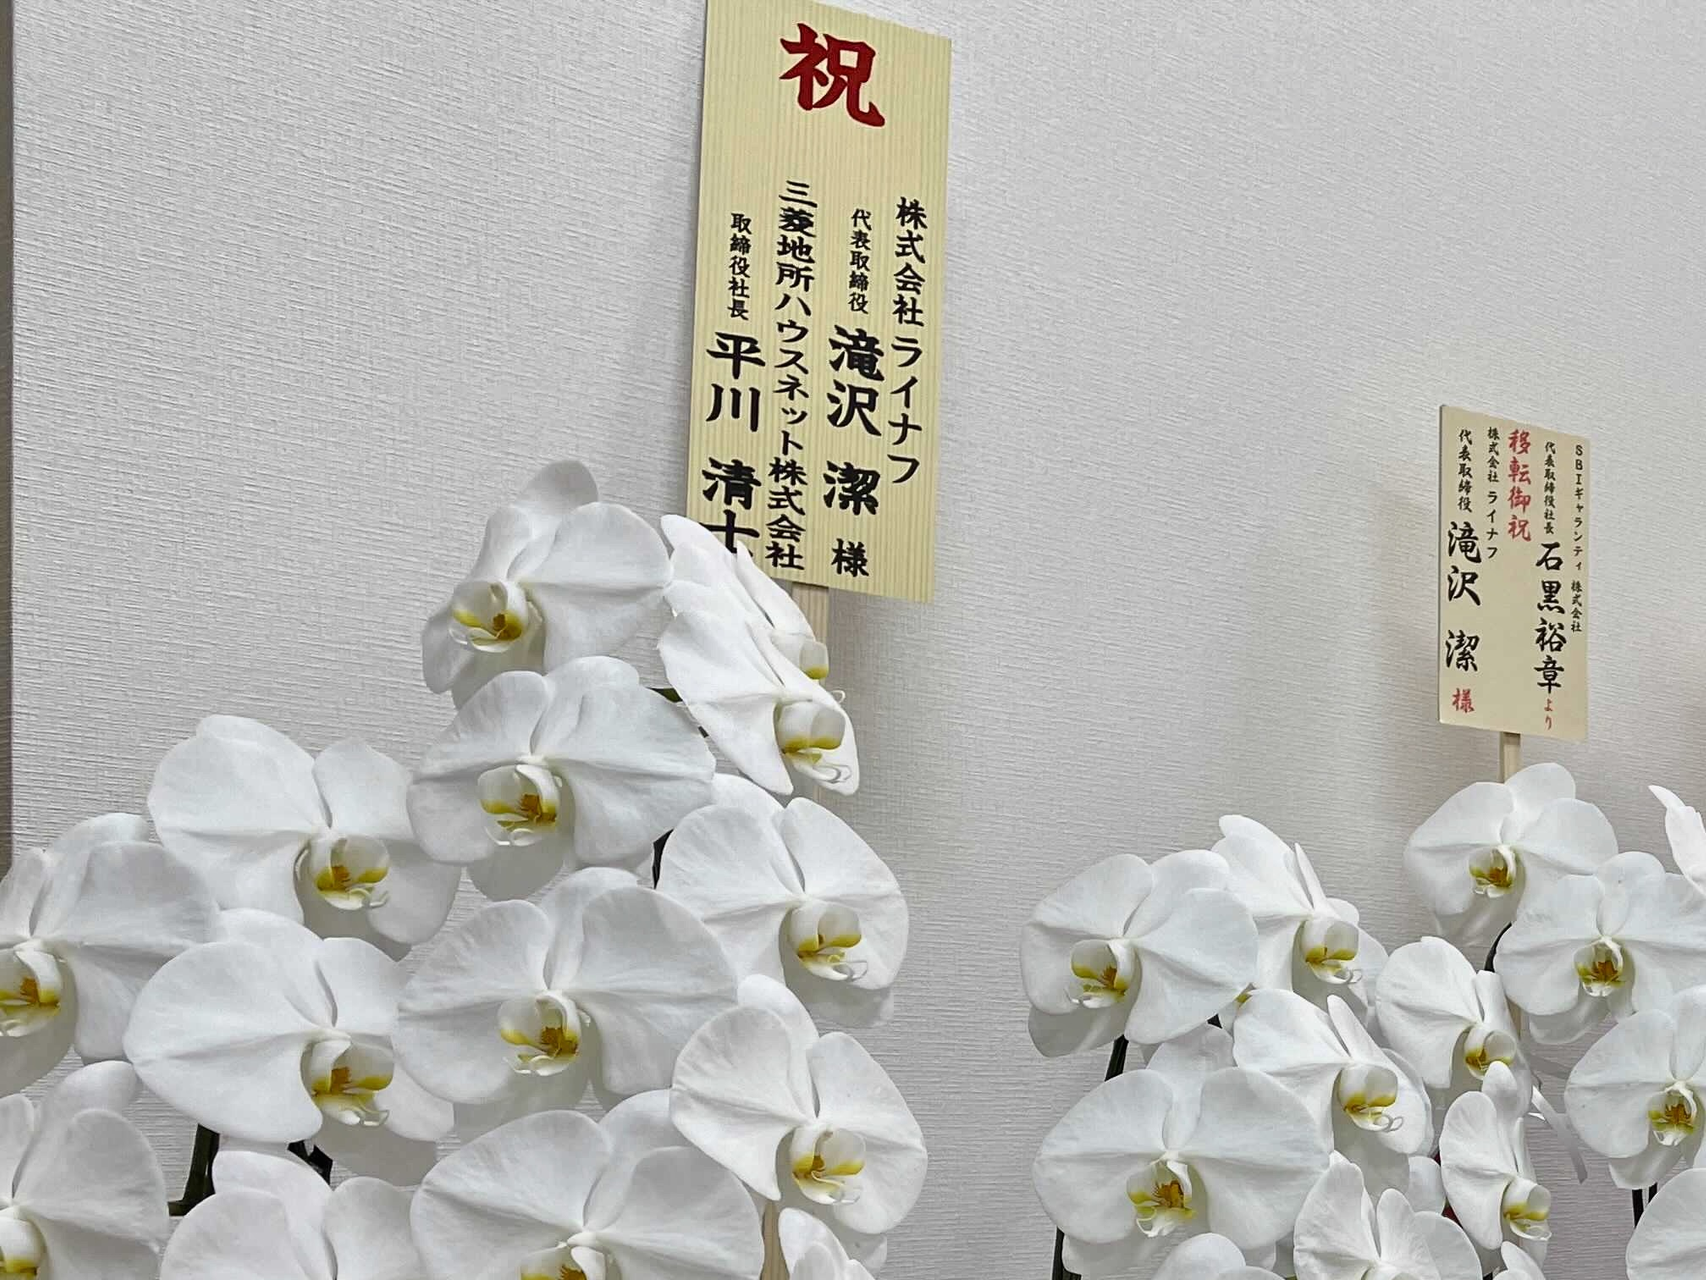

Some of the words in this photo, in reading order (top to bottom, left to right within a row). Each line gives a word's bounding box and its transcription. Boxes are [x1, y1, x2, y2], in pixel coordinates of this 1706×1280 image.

[779, 22, 885, 127] 祝
[727, 213, 751, 321] 取締役社長
[848, 208, 871, 314] 代表取締役
[705, 331, 766, 432] 平川
[765, 179, 817, 570] 三菱地所ハウスネット株式会社
[826, 323, 884, 437] 滝沢
[887, 196, 927, 484] 株式会社ライナフ
[823, 459, 879, 515] 潔
[1458, 429, 1472, 513] 代表取締役
[1486, 426, 1500, 559] 株式会社ライナフ
[1507, 428, 1531, 542] 移転御祝
[1544, 441, 1556, 535] 代表取締役社長
[831, 538, 870, 577] 様
[1448, 521, 1481, 606] 滝沢
[1570, 580, 1582, 632] 株式会社
[1445, 629, 1480, 672] 潔
[1534, 541, 1567, 694] 石黒裕章
[1452, 688, 1474, 713] 様
[1544, 698, 1553, 731] より
